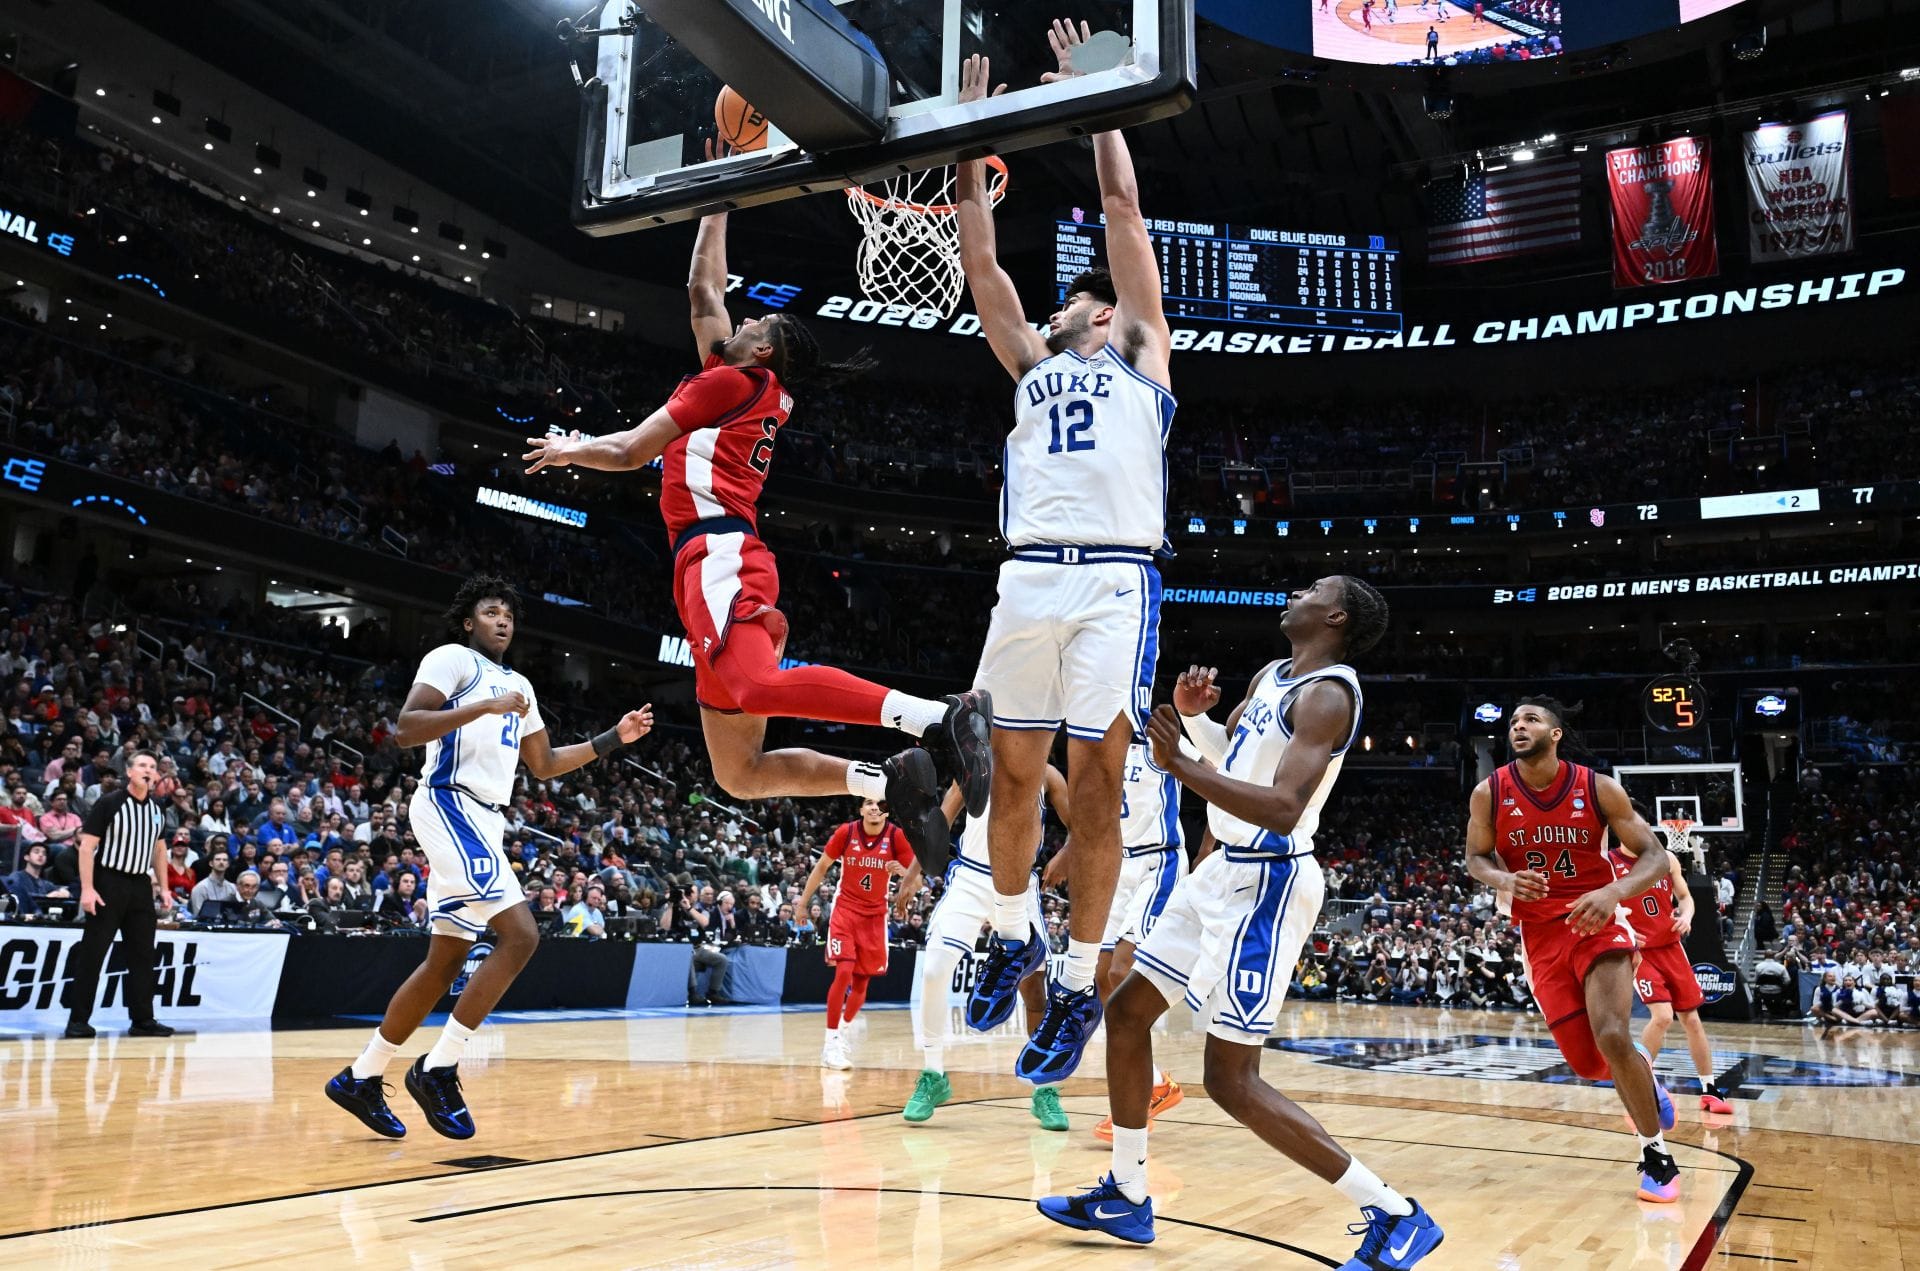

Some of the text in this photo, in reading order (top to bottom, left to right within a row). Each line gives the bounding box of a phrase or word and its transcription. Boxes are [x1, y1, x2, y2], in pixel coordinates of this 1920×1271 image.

[1613, 142, 1704, 170] STANLEY CUP
[1750, 140, 1843, 167] bullets
[1619, 159, 1700, 185] CHAMPIONS
[1779, 167, 1813, 186] NBA
[1154, 219, 1175, 232] RED
[1177, 221, 1215, 236] STORM
[1250, 229, 1346, 246] DUKE BLUE DEVILS
[1057, 233, 1219, 259] DARLING 3 1 0 4
[1057, 243, 1219, 269] MITCHELL 3 2 0 2
[1057, 253, 1219, 279] SELLERS 1 0 1 1
[1229, 252, 1390, 272] FOSTER 11 3 2 0 0 1
[1229, 262, 1391, 281] EVANS 24 4 0 0 0 1
[1644, 258, 1686, 281] 2018
[1163, 275, 1169, 284] 3
[1181, 277, 1187, 286] 1
[1197, 279, 1204, 288] 0
[1213, 280, 1219, 289] 2
[1163, 285, 1169, 294] 6
[1182, 287, 1187, 296] 1
[1198, 288, 1203, 297] 1
[1213, 290, 1219, 298] 2
[1229, 272, 1391, 291] SARR 2 5 3 1 0 0
[1230, 281, 1391, 301] BOOZER 20 10 3 0 1 1
[816, 295, 943, 331] 2026
[949, 313, 987, 338] D
[1170, 326, 1456, 354] BASKETBALL
[1473, 268, 1905, 344] CHAMPIONSHIP
[1230, 291, 1392, 310] NGONGBA 3 2 1 0 0 2
[1026, 373, 1113, 408] DUKE
[1047, 400, 1096, 455] 12
[476, 486, 588, 528] MARCHMADNESS
[1278, 527, 1289, 536] 19
[1323, 526, 1330, 535] 7
[1367, 525, 1374, 534] 3
[1557, 519, 1564, 528] 1
[1637, 505, 1658, 521] 72
[1790, 495, 1801, 508] 2
[1853, 487, 1874, 504] 77
[1451, 516, 1475, 525] BONUS
[1507, 514, 1520, 523] FLS
[1553, 511, 1567, 520] TOL
[1063, 547, 1079, 563] D
[1547, 564, 1920, 601] 2026 DI MEN'S BASKETBALL CHAMPI
[1162, 588, 1288, 606] RCHMADNESS
[1653, 688, 1685, 702] 52.7
[1242, 697, 1273, 736] UKE
[1676, 702, 1694, 727] 5
[501, 712, 519, 750] 21
[1225, 724, 1250, 772] 7
[1508, 825, 1589, 847] ST. JOHN'S
[473, 857, 492, 875] D
[859, 856, 884, 869] JOHN
[1525, 848, 1577, 880] 24
[860, 873, 872, 892] 4
[1642, 895, 1660, 917] 0
[1238, 970, 1263, 994] D
[1639, 979, 1654, 998] SJ
[1701, 982, 1734, 992] ADNESS
